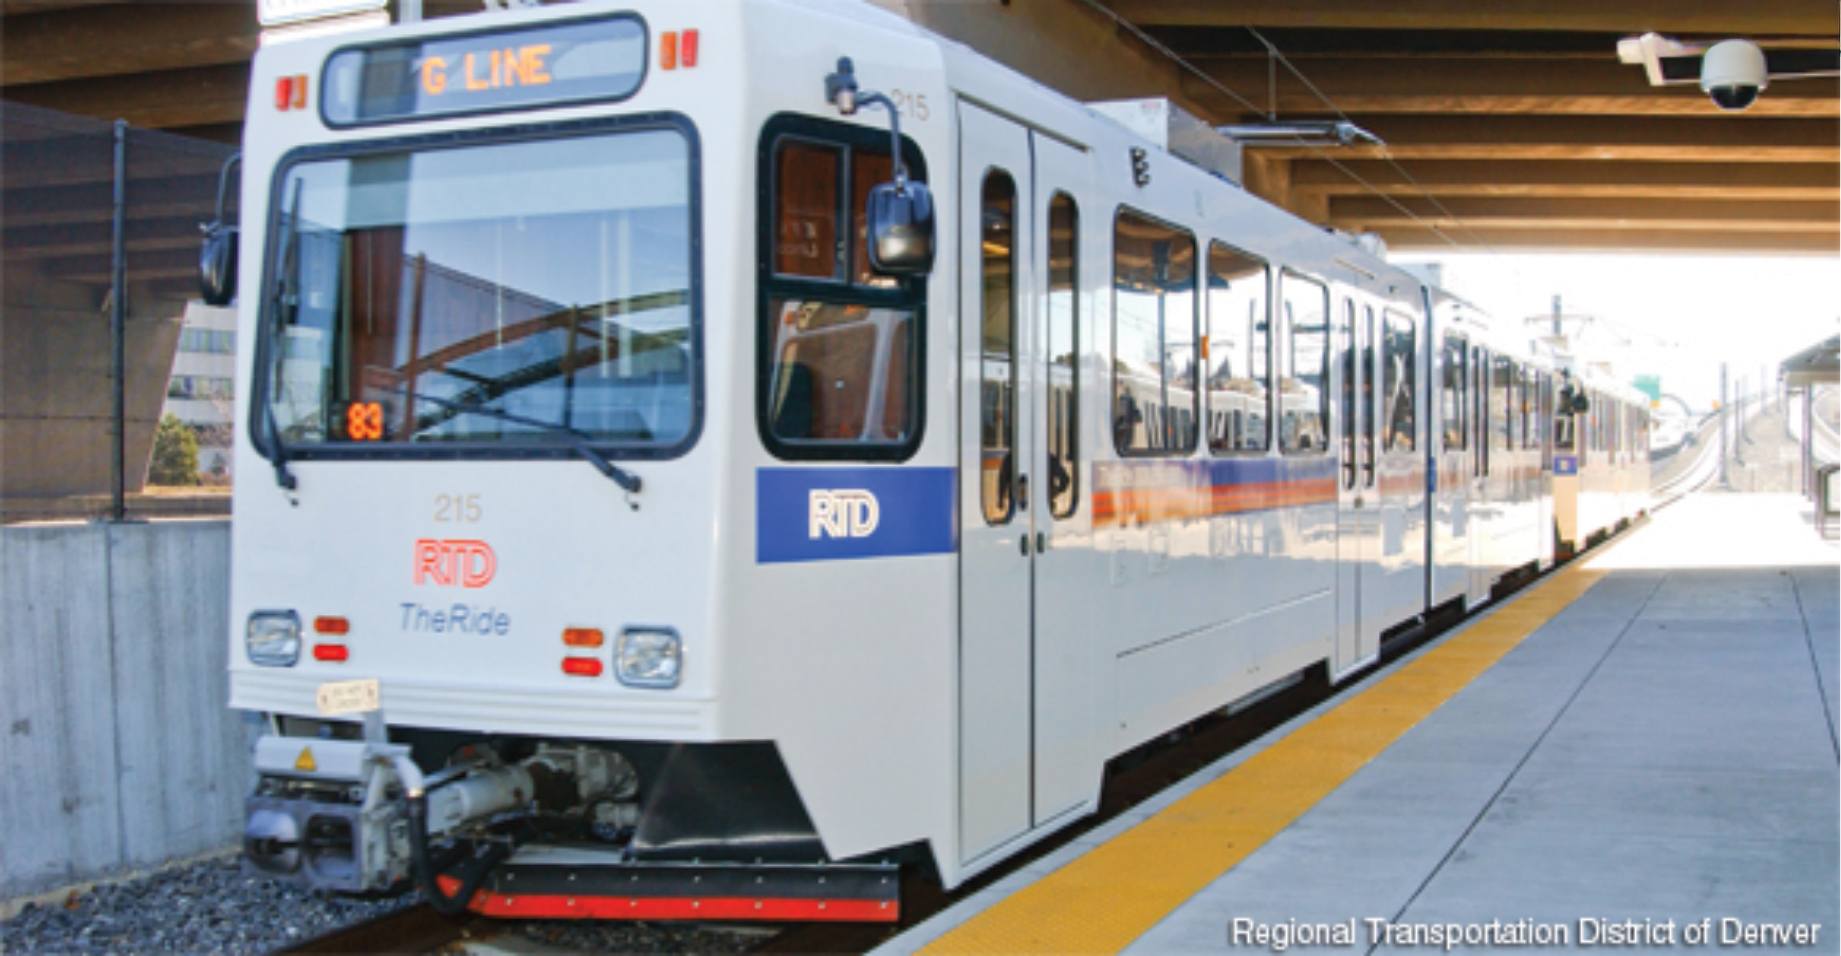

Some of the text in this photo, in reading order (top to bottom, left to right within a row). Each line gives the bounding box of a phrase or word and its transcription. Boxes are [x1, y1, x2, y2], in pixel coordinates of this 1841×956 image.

[422, 43, 553, 96] G LINE
[348, 402, 384, 440] 83
[432, 493, 483, 523] 215
[808, 488, 880, 539] RTD
[412, 537, 497, 589] RTD
[401, 602, 511, 636] TheRide
